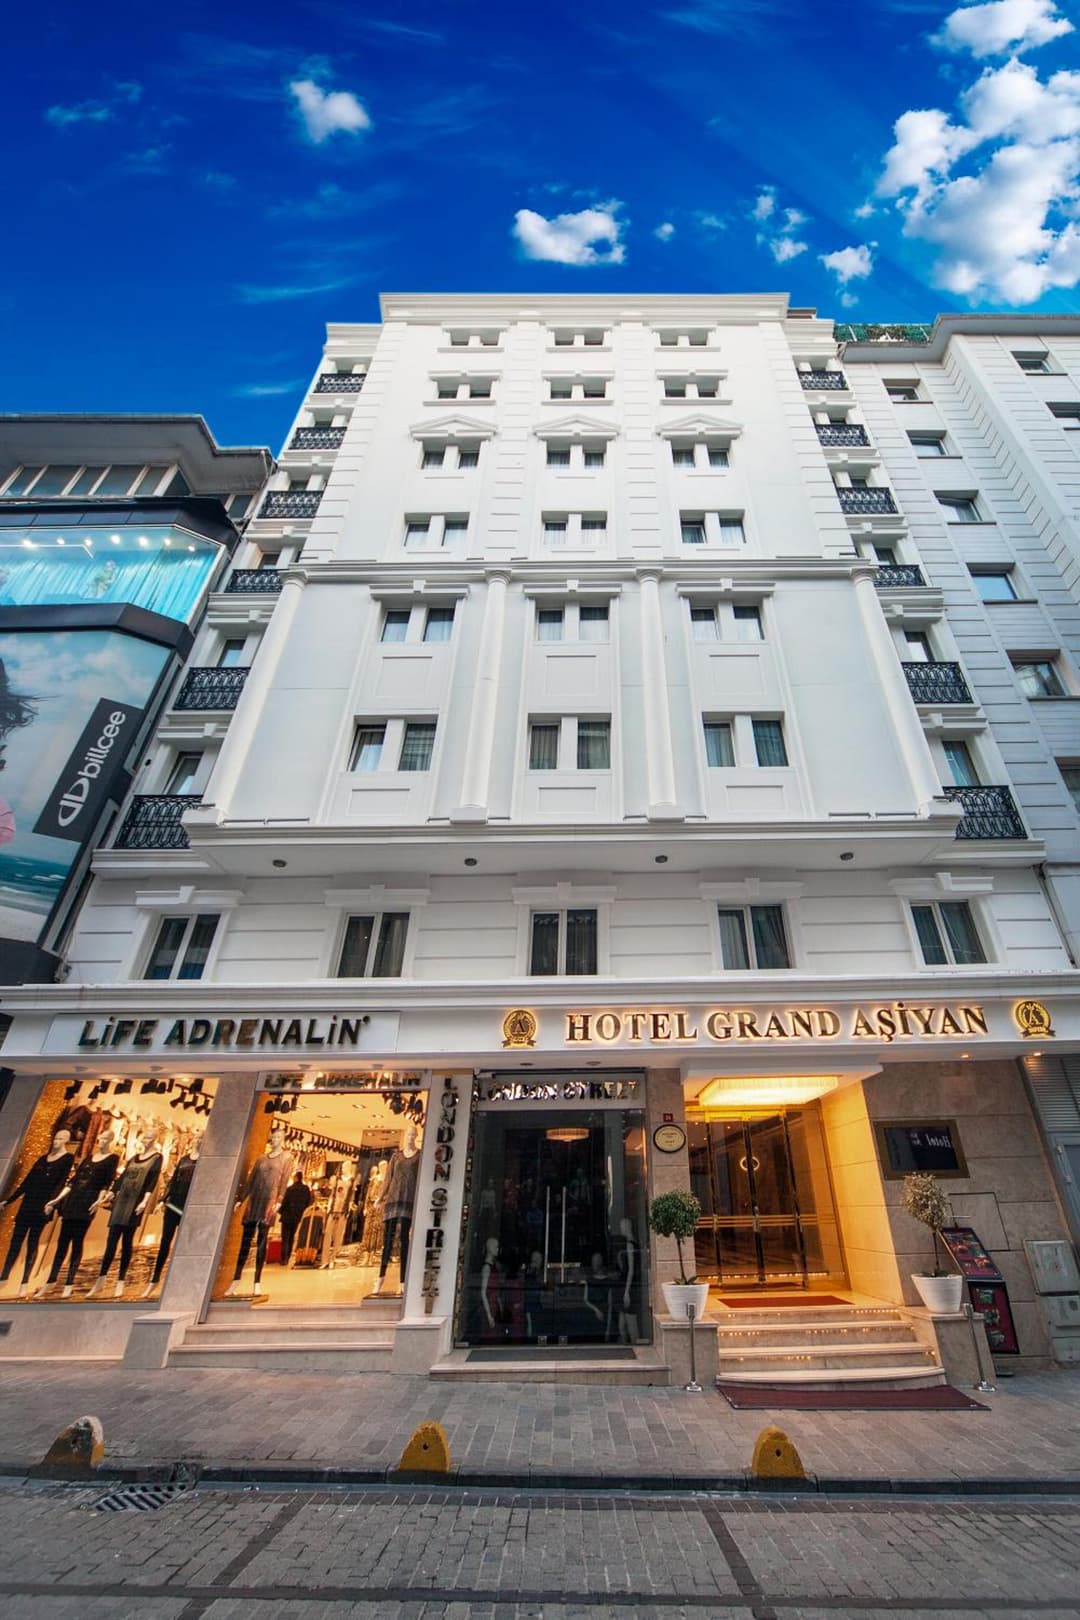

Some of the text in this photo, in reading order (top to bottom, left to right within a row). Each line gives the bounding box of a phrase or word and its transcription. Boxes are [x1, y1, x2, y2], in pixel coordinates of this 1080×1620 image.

[77, 711, 126, 779] billcee
[566, 1002, 989, 1043] HOTEL GRAND AŞİYAN
[421, 1072, 459, 1315] LONDON STREET
